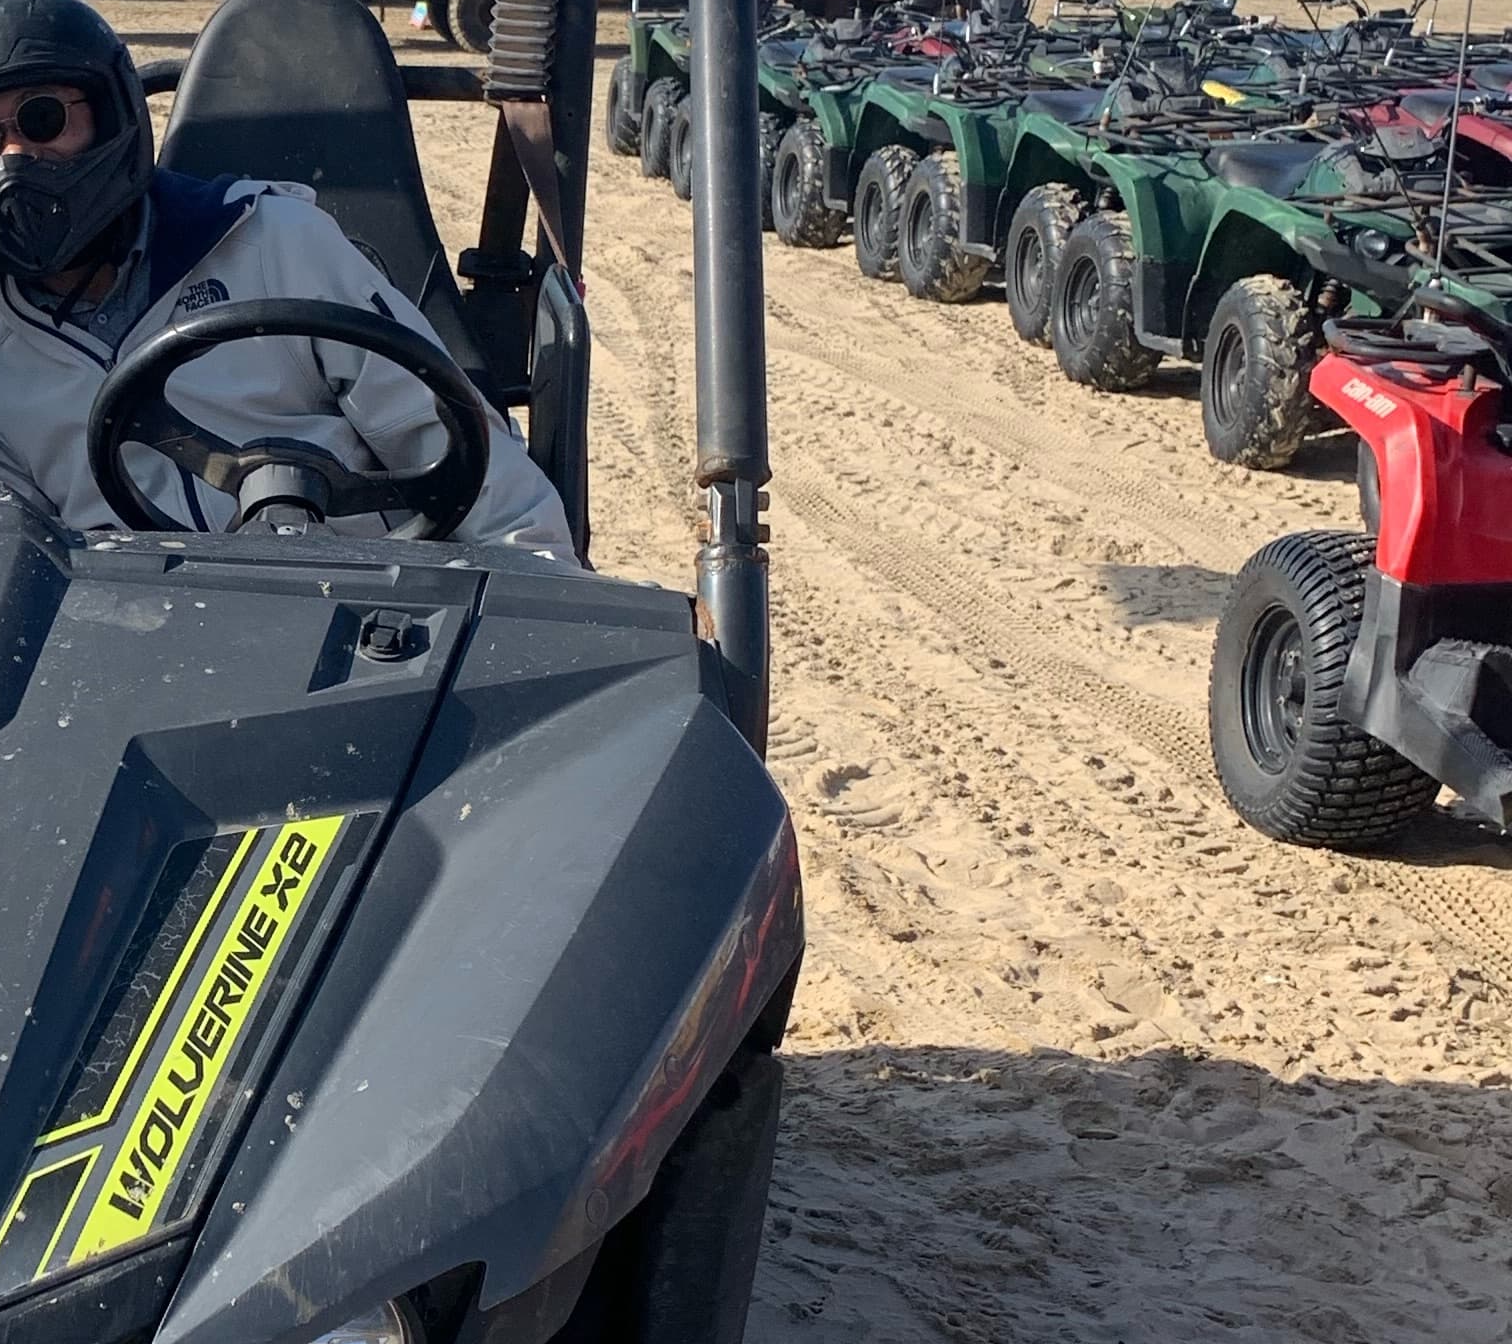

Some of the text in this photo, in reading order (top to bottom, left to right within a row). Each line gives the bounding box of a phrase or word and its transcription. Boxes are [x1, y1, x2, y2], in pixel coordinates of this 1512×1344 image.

[189, 280, 207, 295] THE
[185, 297, 211, 313] FACE
[1340, 377, 1399, 419] can-am
[108, 831, 318, 1222] WOLVERINE X2
